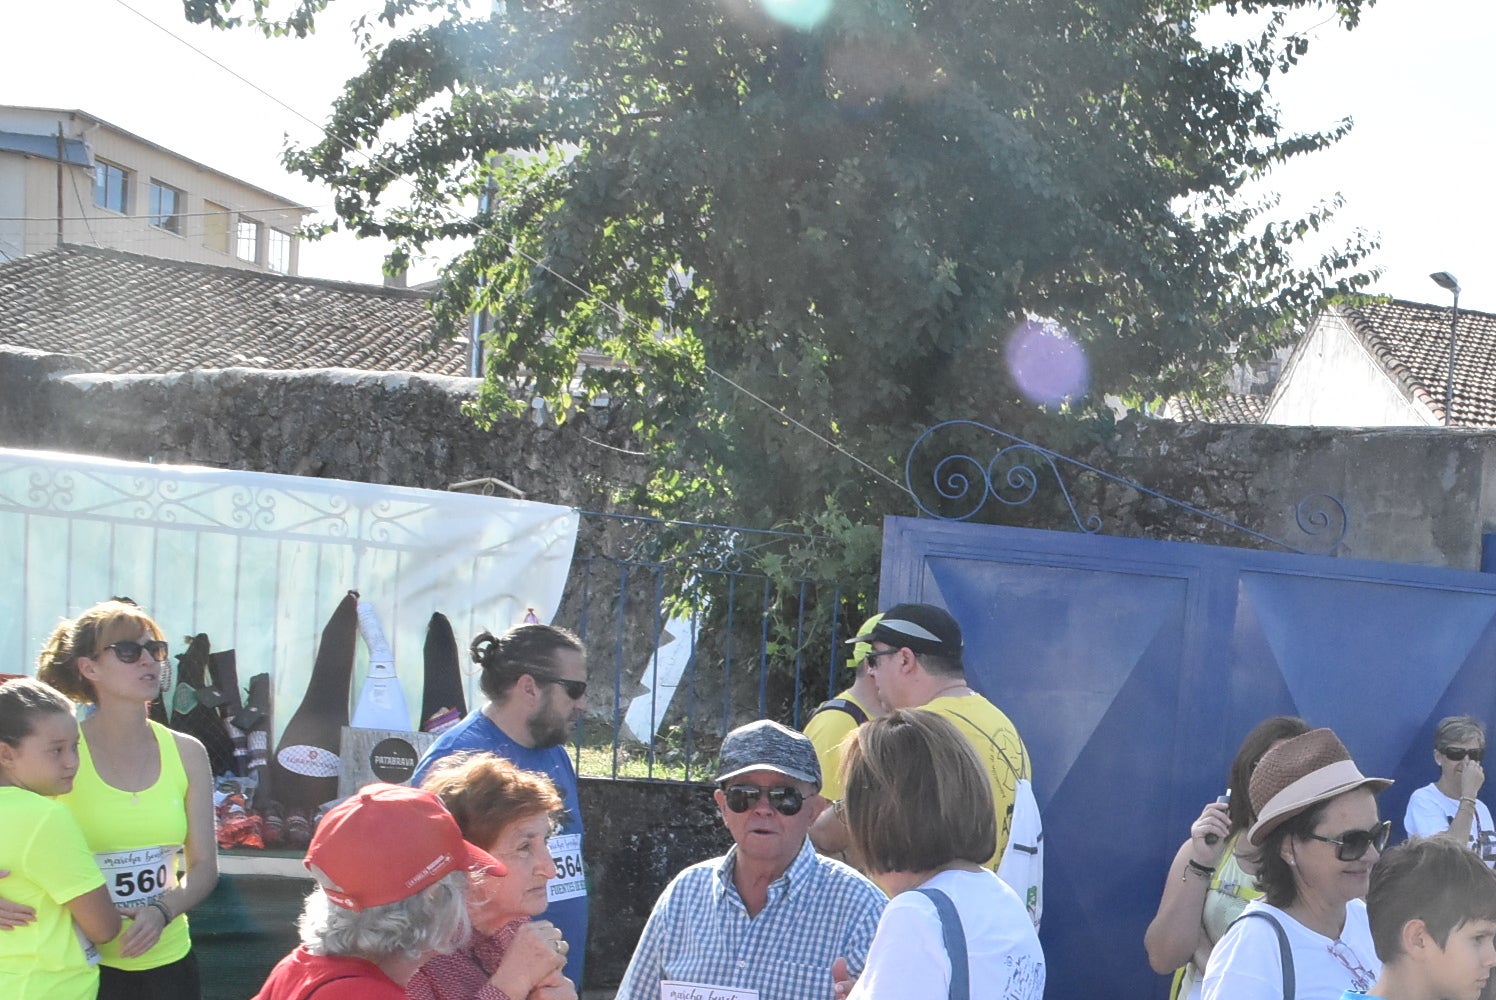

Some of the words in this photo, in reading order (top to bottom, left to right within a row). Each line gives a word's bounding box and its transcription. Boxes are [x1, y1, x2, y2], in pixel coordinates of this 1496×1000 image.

[374, 755, 415, 767] PATABRAVA
[104, 851, 141, 866] marcha
[553, 853, 582, 879] 564
[115, 864, 167, 897] 560
